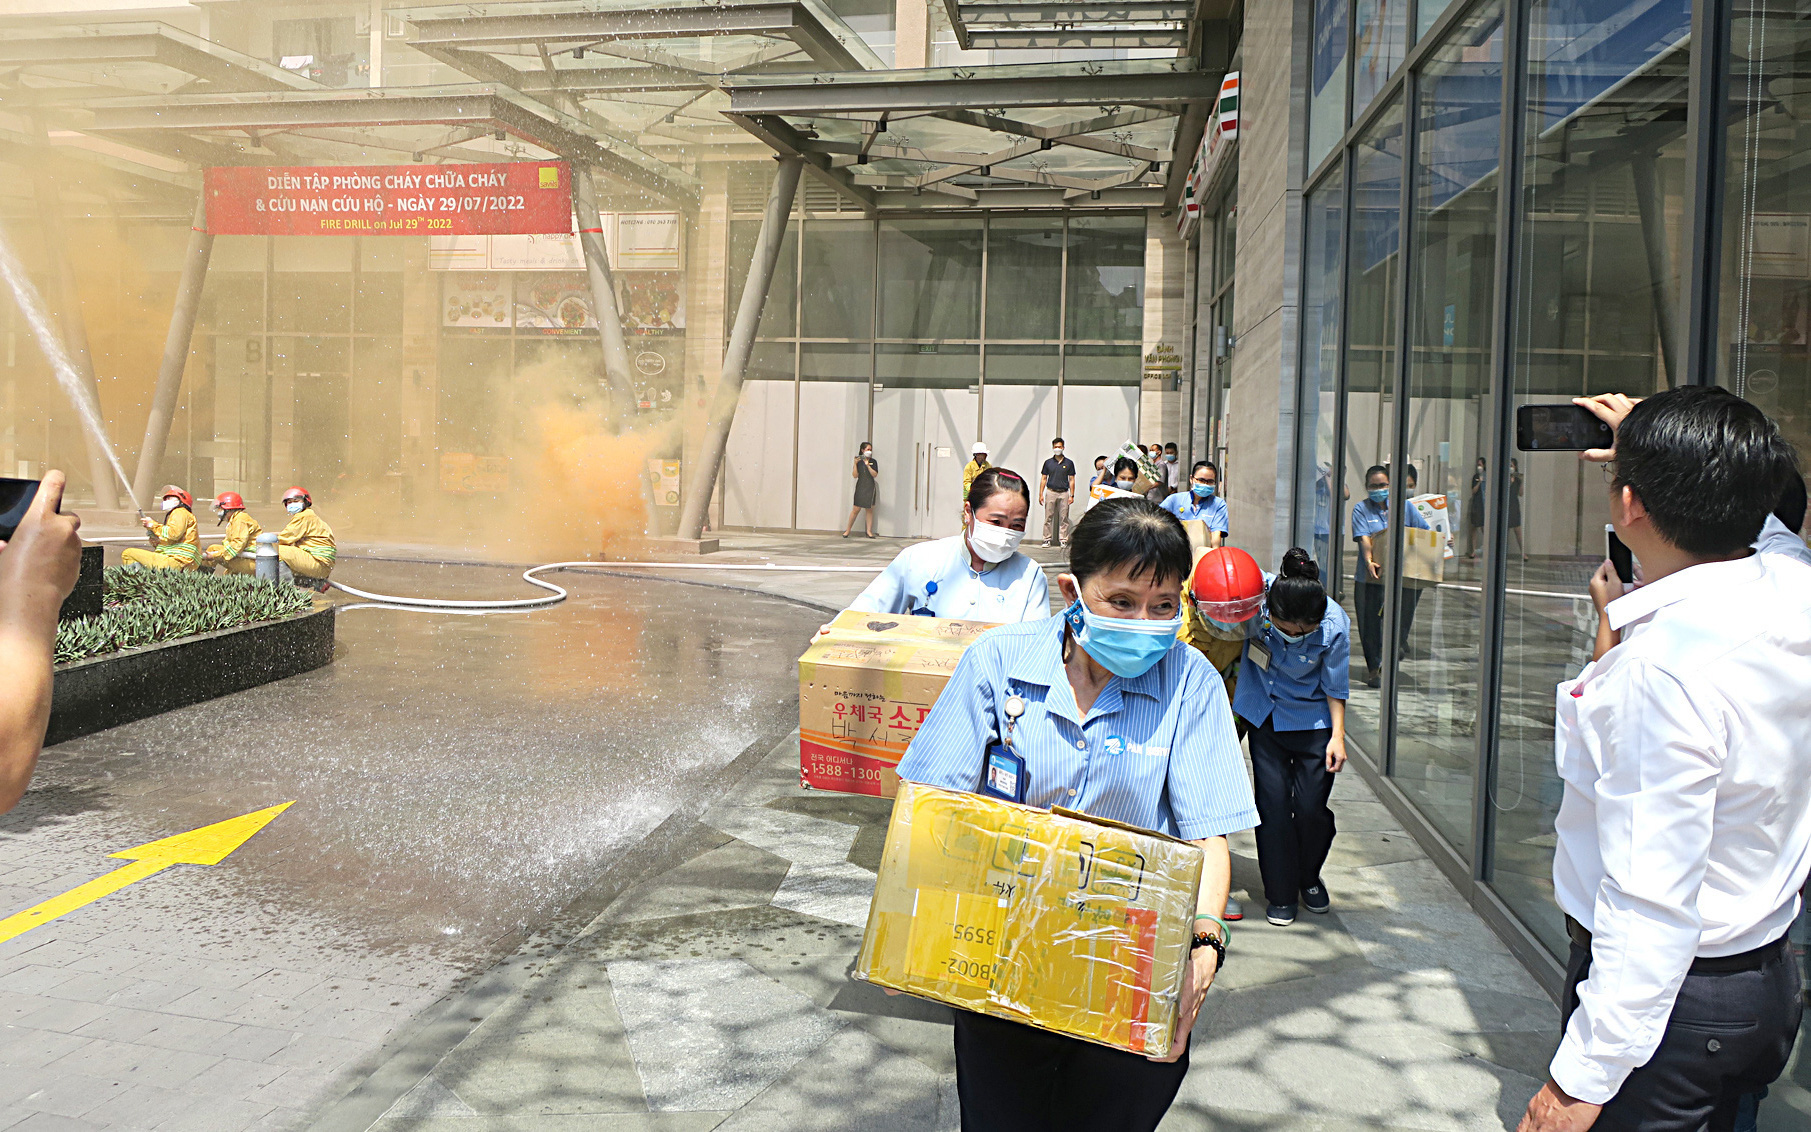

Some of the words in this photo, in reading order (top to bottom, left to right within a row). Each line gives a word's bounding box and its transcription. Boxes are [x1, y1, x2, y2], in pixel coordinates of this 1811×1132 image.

[267, 172, 301, 190] DIỄN
[303, 172, 330, 192] TẬP
[333, 171, 381, 189] PHÒNG
[384, 171, 422, 189] CHÁY
[425, 170, 466, 189] CHỮA
[468, 169, 507, 187] CHÁY
[256, 198, 266, 212] &
[268, 194, 297, 212] CỨU
[300, 198, 329, 215] NẠN
[331, 194, 360, 212] CỨU
[363, 194, 384, 215] HỘ
[397, 194, 436, 212] NGÀY
[439, 195, 525, 213] 29/07/2022
[320, 219, 342, 229] FIRE
[343, 219, 372, 229] DRILL
[373, 221, 387, 229] on
[388, 219, 403, 229] Jul
[427, 218, 452, 229] 2022
[542, 327, 583, 336] CONVENIENT
[635, 328, 664, 336] HEALTHY
[832, 702, 884, 725] 우체국
[810, 753, 825, 761] 전국
[811, 762, 881, 781] 1588-1300
[953, 924, 996, 946] 3595
[940, 957, 990, 980] B002-
